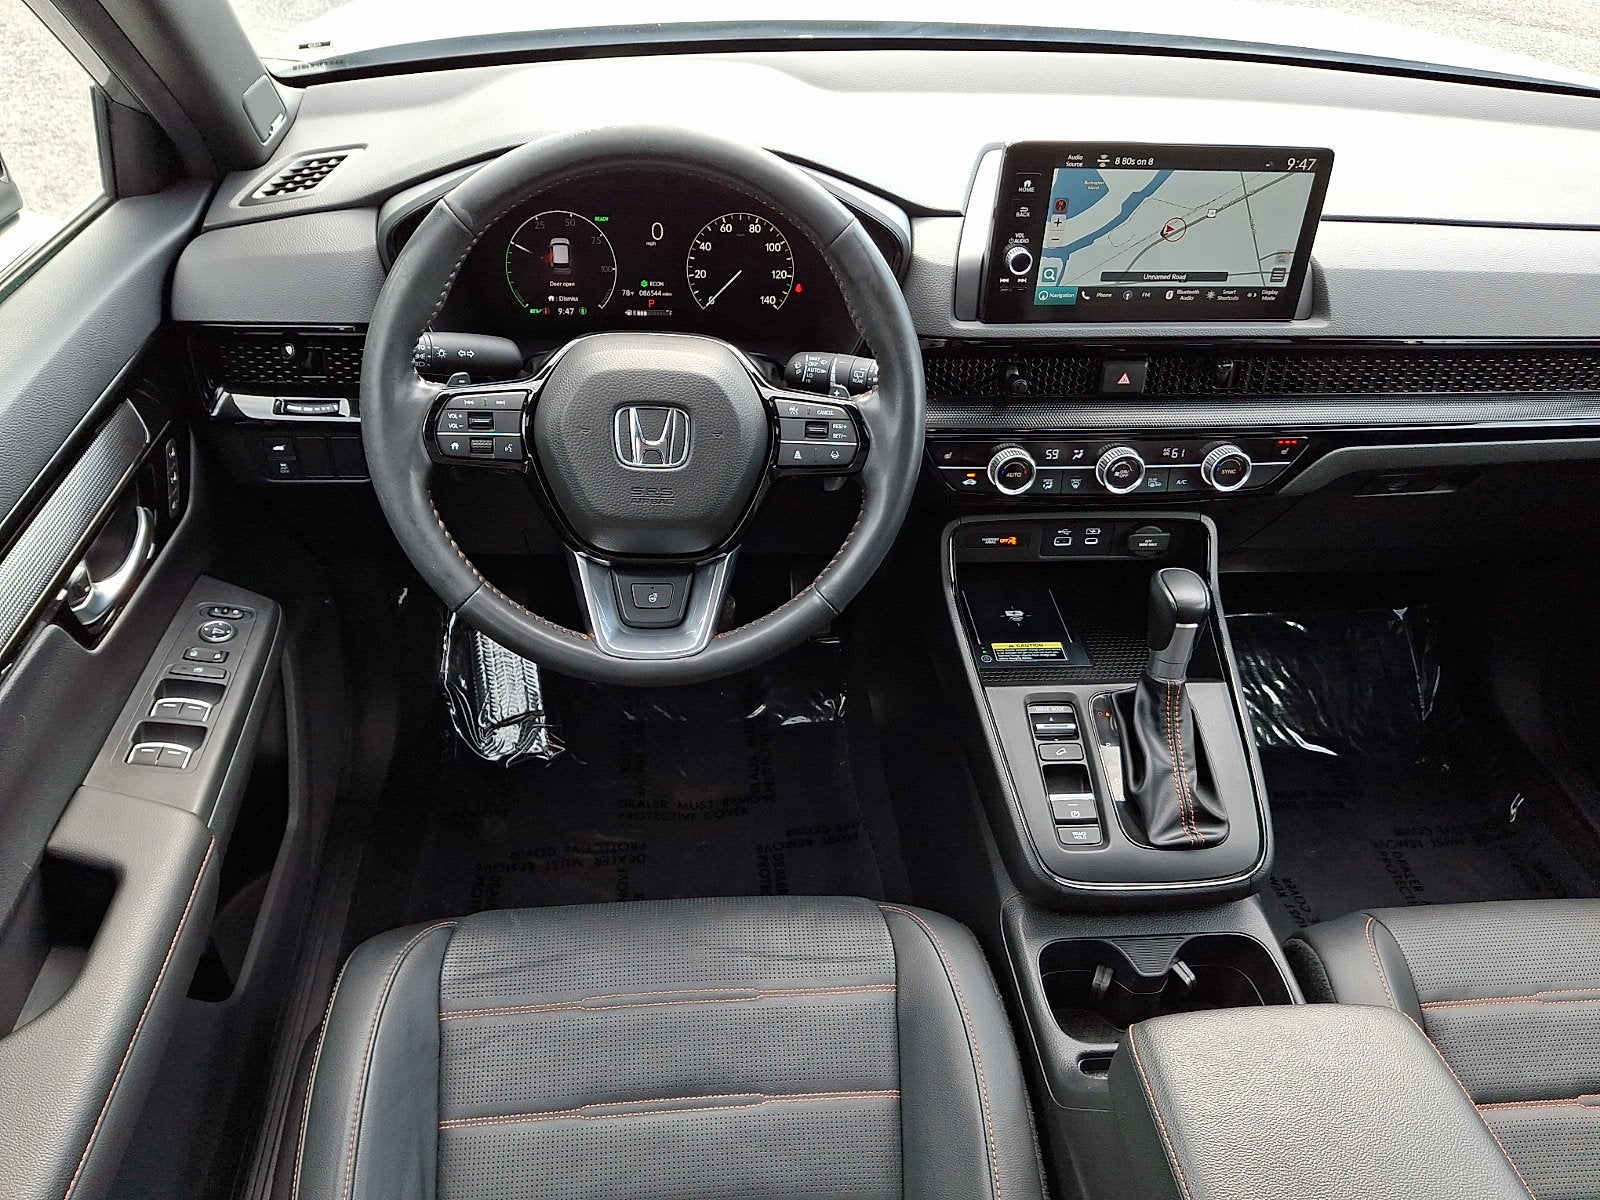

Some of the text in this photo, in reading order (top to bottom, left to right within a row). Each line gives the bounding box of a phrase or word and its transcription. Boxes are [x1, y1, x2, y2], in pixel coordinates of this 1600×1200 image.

[1114, 157, 1121, 165] 8
[1121, 157, 1135, 165] 80s
[1147, 157, 1154, 165] 8
[1286, 157, 1317, 171] 9:47
[534, 221, 545, 230] 25
[565, 219, 576, 227] 50
[720, 223, 733, 233] 60
[748, 223, 762, 233] 80
[651, 222, 664, 241] 0
[591, 236, 601, 245] 75
[699, 242, 712, 252] 40
[765, 242, 781, 252] 100
[600, 265, 613, 273] 100
[694, 269, 707, 279] 20
[771, 269, 787, 280] 120
[759, 295, 776, 305] 140
[557, 307, 575, 315] 9:47
[806, 366, 821, 374] AUTO
[1045, 449, 1059, 460] 59
[1171, 447, 1186, 459] 61
[630, 486, 674, 497] SRS
[618, 798, 668, 810] DEALER
[676, 800, 712, 811] MUST
[703, 806, 749, 820] COVER
[594, 851, 647, 867] DEALER
